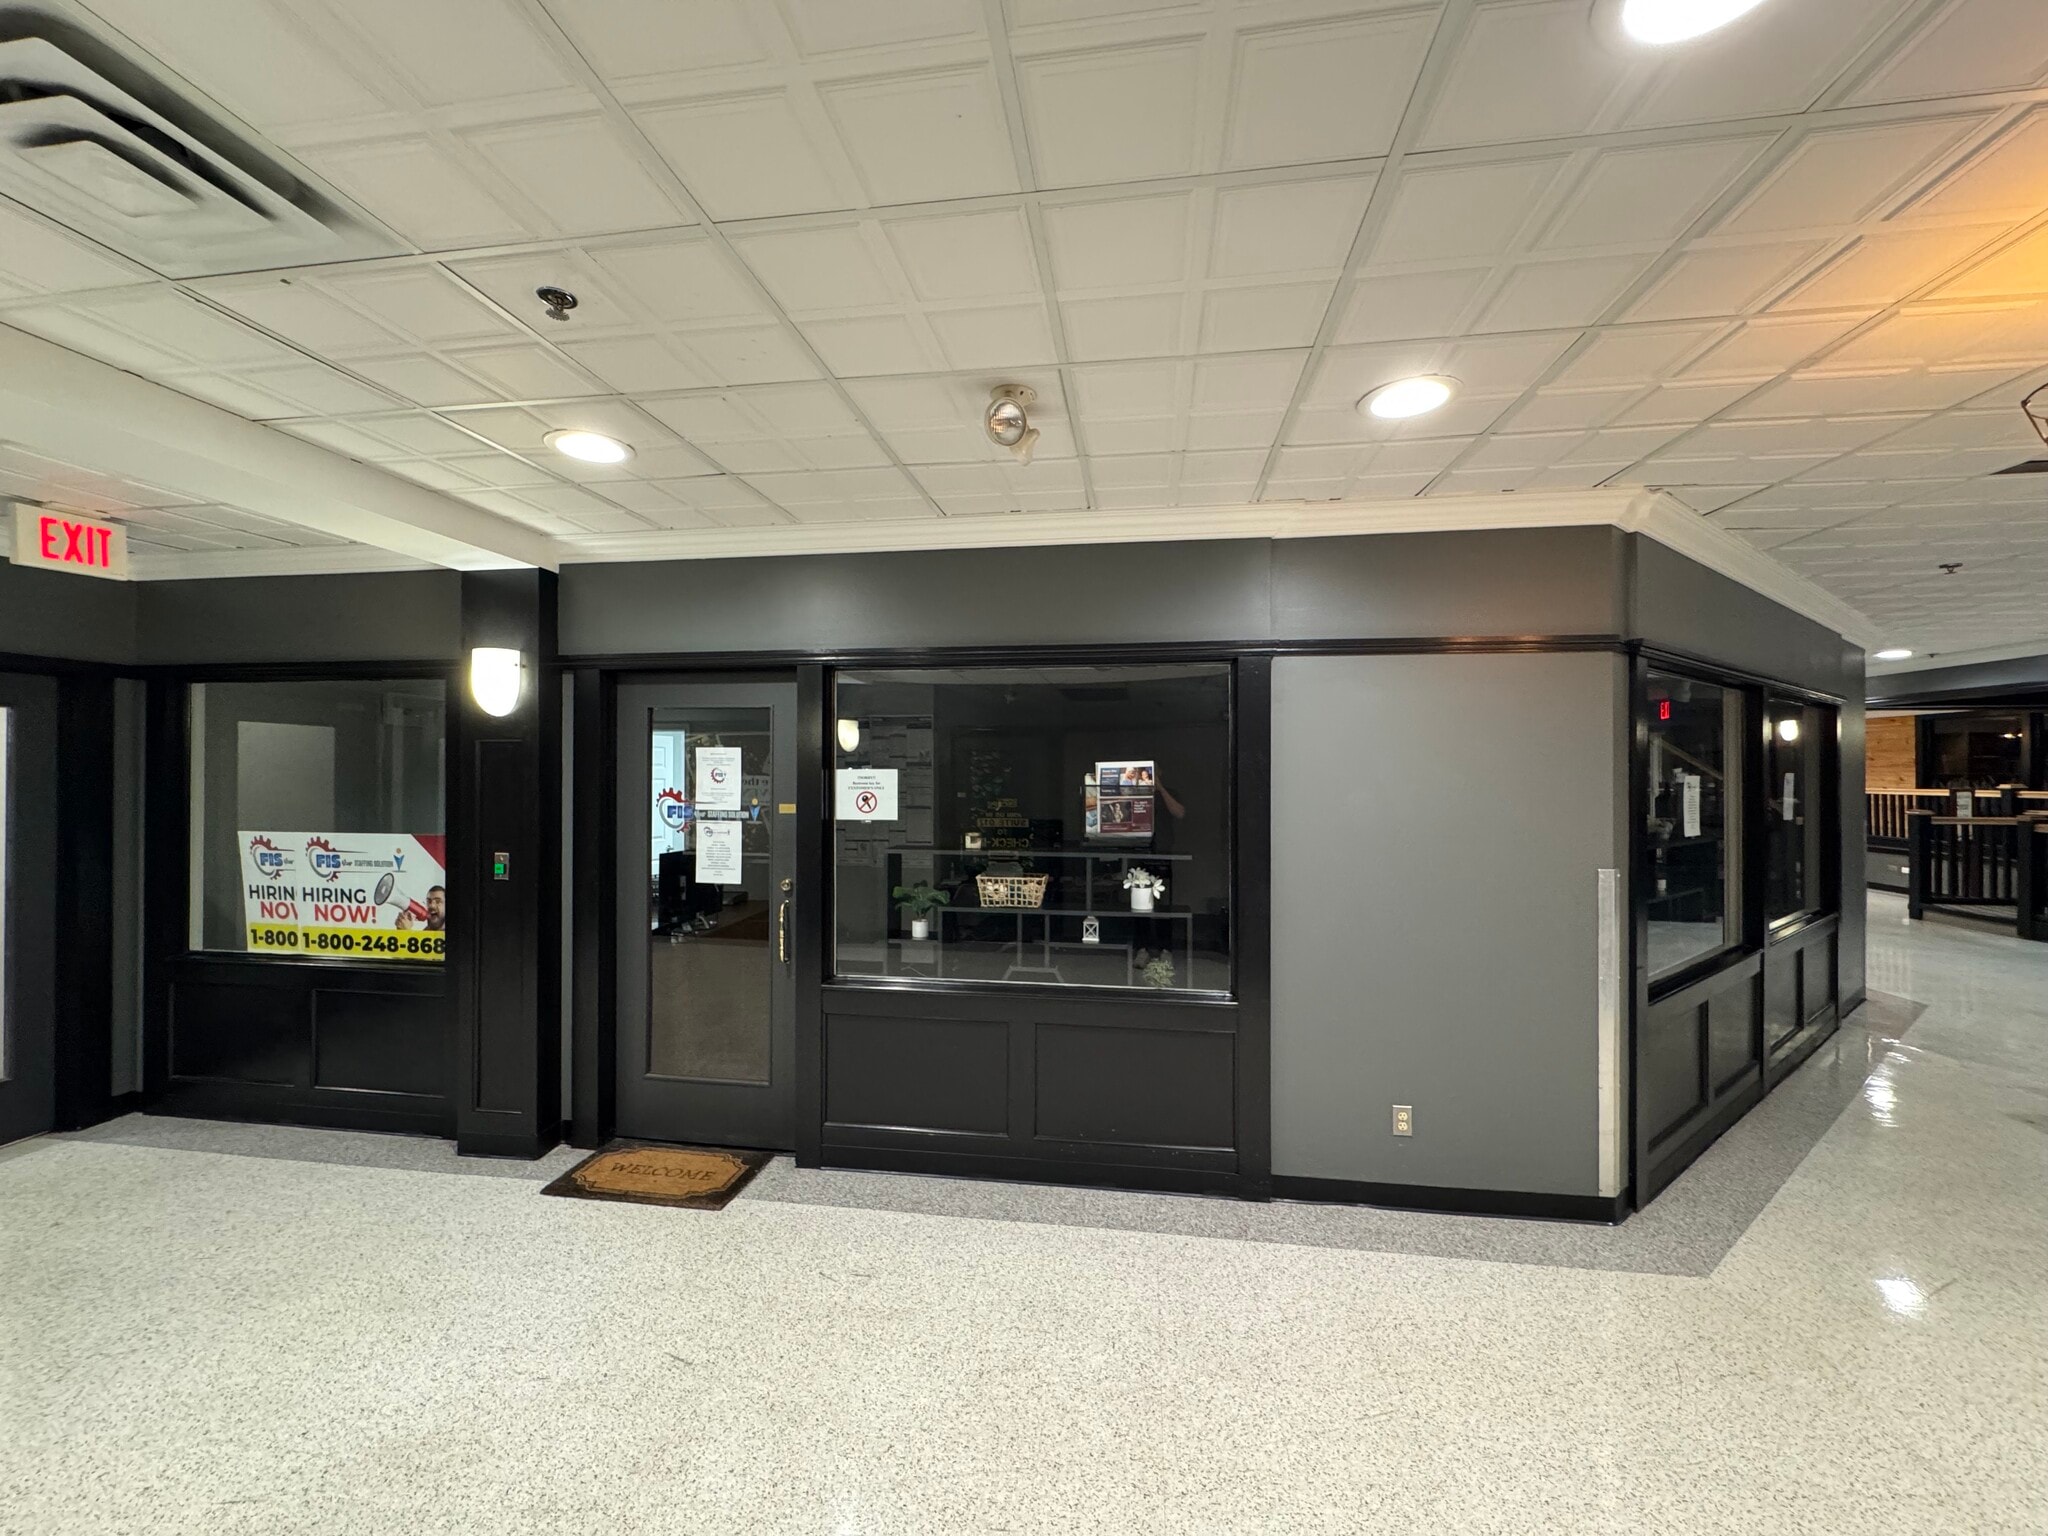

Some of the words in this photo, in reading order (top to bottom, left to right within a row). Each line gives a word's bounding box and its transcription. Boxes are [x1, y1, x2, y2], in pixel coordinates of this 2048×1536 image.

[40, 516, 112, 568] EXIT
[667, 805, 694, 818] FIS
[259, 852, 283, 867] FIS
[316, 854, 341, 868] FIS
[354, 860, 373, 868] STAFFING
[249, 885, 297, 901] HIRIN
[302, 887, 367, 904] HIRING
[314, 904, 377, 924] NOW!
[250, 929, 298, 946] 1-800
[611, 1161, 717, 1181] WELCOME
